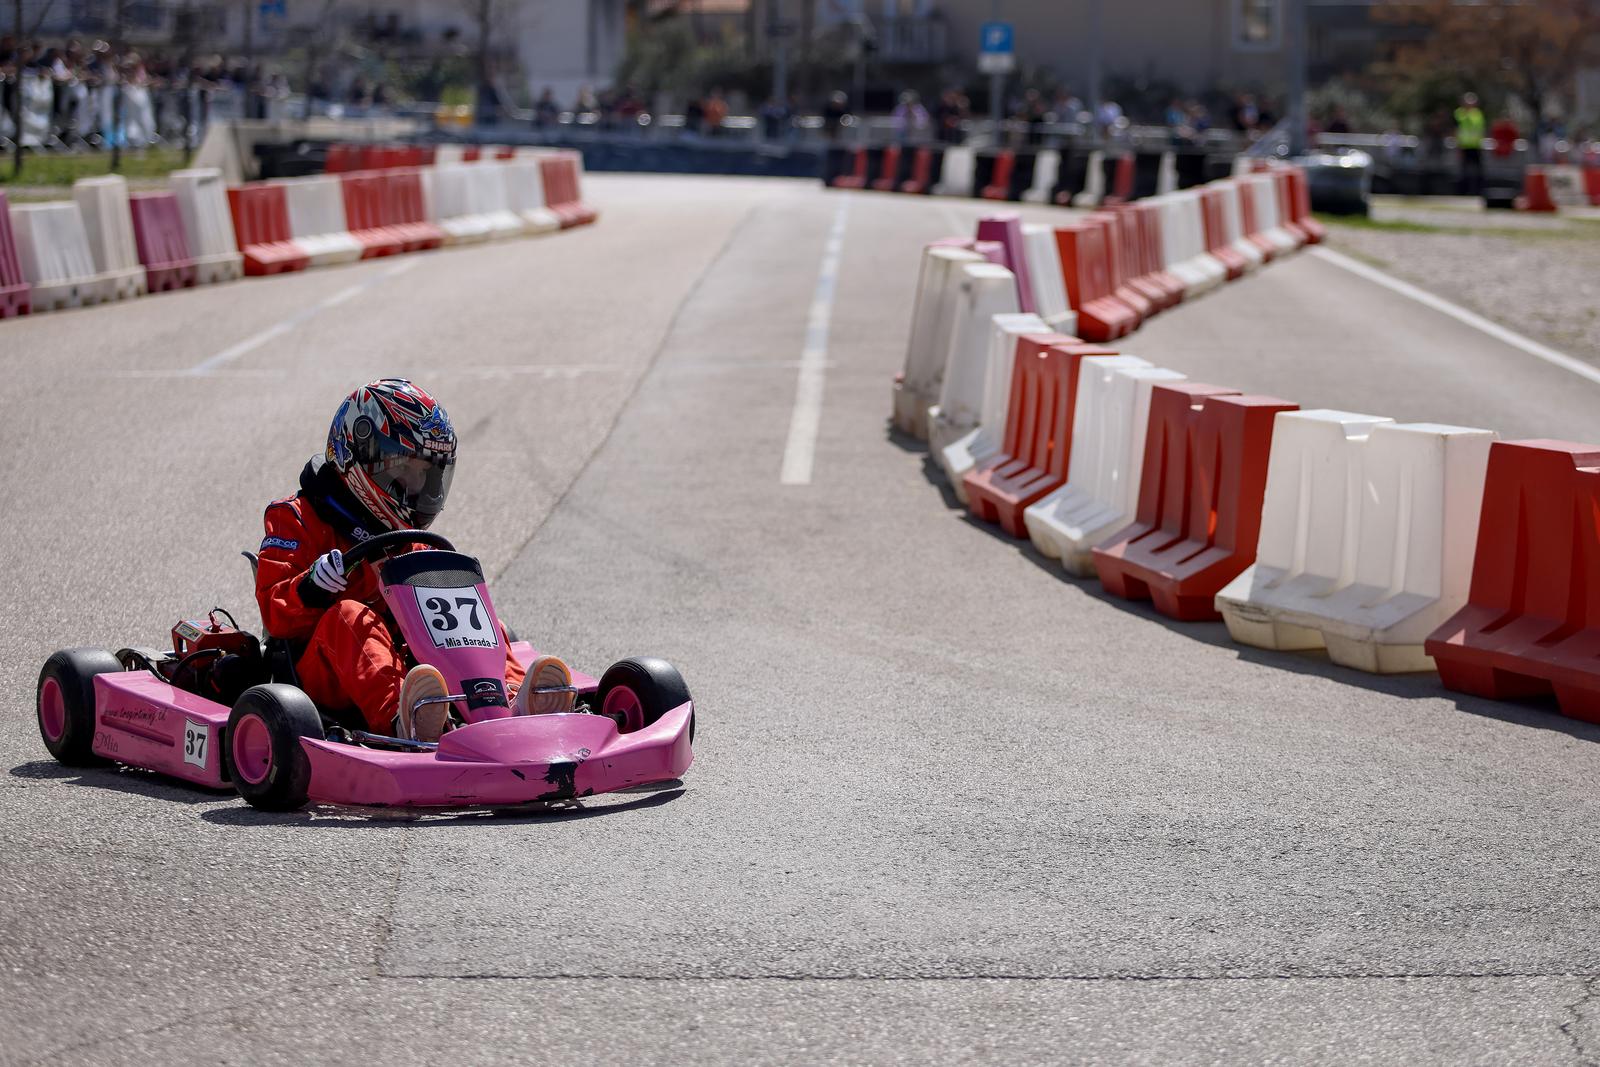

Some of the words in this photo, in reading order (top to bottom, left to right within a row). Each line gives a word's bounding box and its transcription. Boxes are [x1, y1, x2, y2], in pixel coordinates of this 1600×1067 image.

[424, 440, 453, 452] SHARK
[425, 596, 482, 631] 37
[445, 637, 462, 648] Mia
[462, 637, 492, 647] Barada
[186, 729, 206, 759] 37
